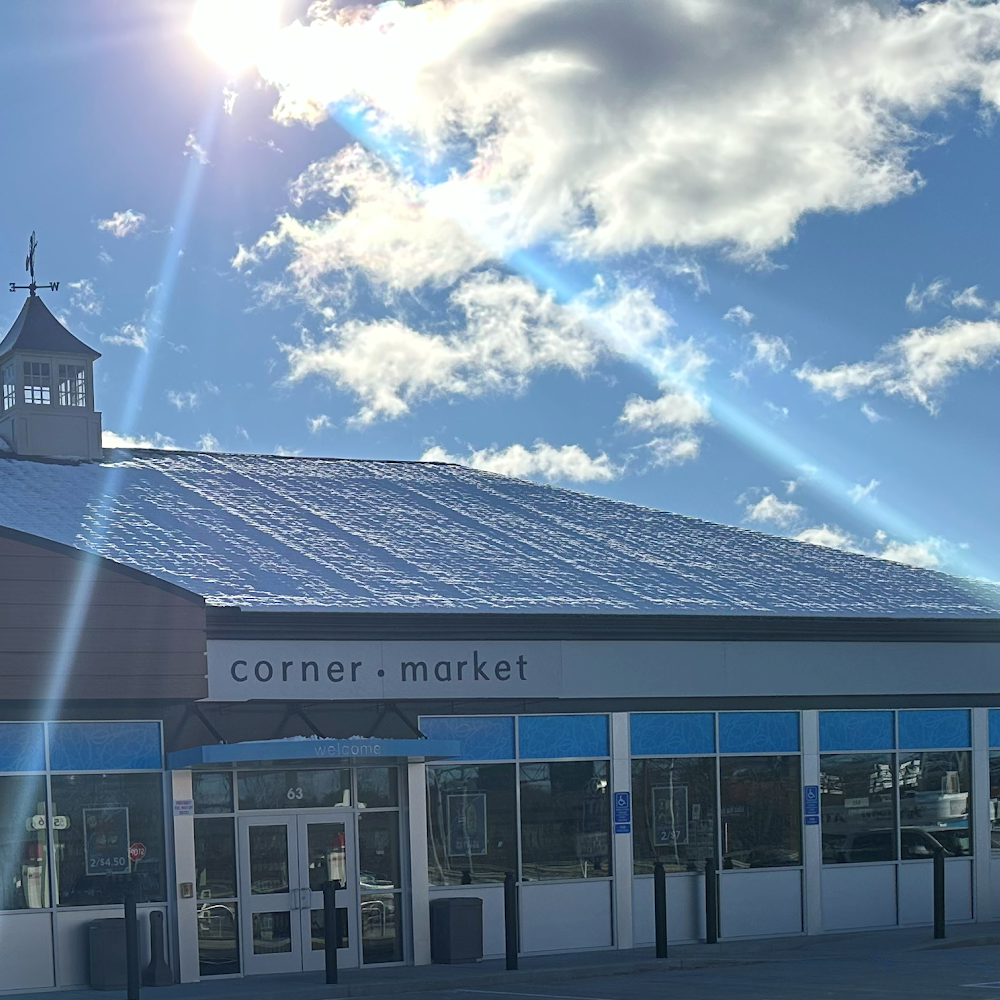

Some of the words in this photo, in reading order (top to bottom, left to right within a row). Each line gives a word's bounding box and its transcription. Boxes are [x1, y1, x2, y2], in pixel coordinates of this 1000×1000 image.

[231, 659, 362, 683] corner
[401, 650, 528, 682] market
[314, 742, 381, 756] welcome
[286, 787, 304, 800] 63
[89, 857, 126, 868] 2/$4.50
